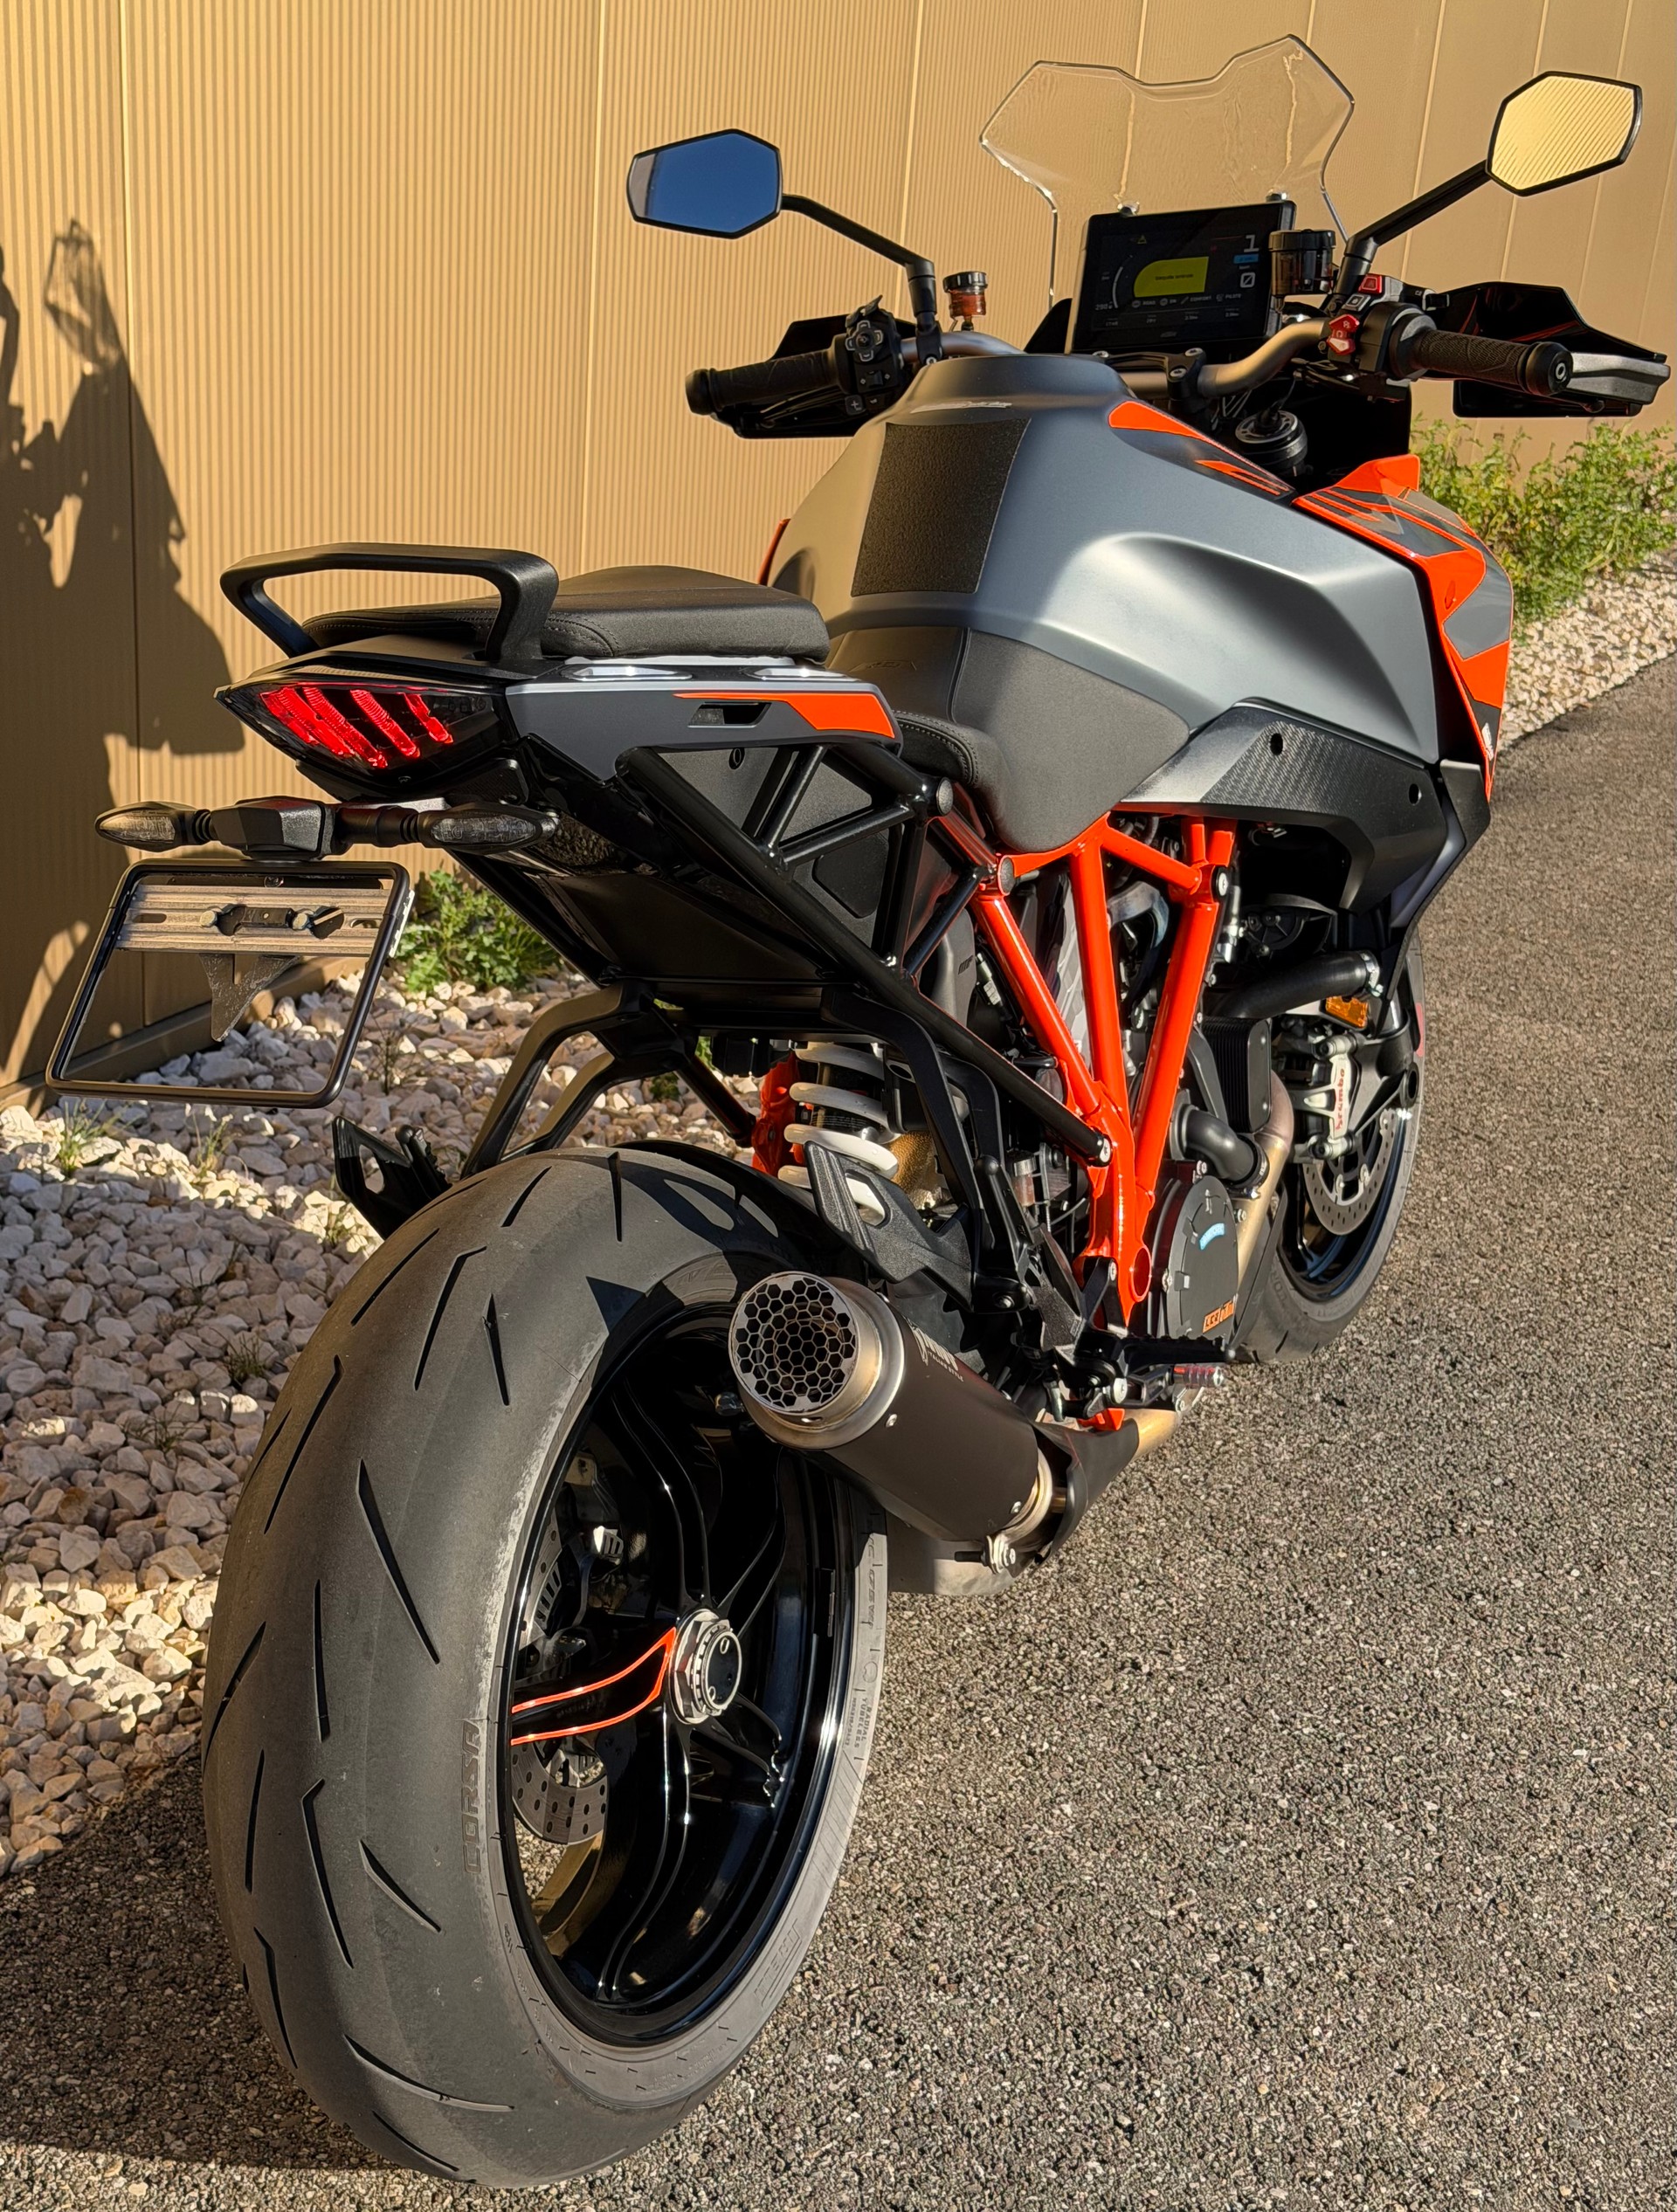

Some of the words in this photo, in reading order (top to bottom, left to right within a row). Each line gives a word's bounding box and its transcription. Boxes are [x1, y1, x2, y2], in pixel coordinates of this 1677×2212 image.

[1244, 234, 1259, 253] 1
[1335, 1068, 1345, 1130] brembo
[854, 1697, 868, 1747] TUBELESS
[861, 1706, 872, 1741] RADIAL
[461, 1719, 482, 1872] CORSA
